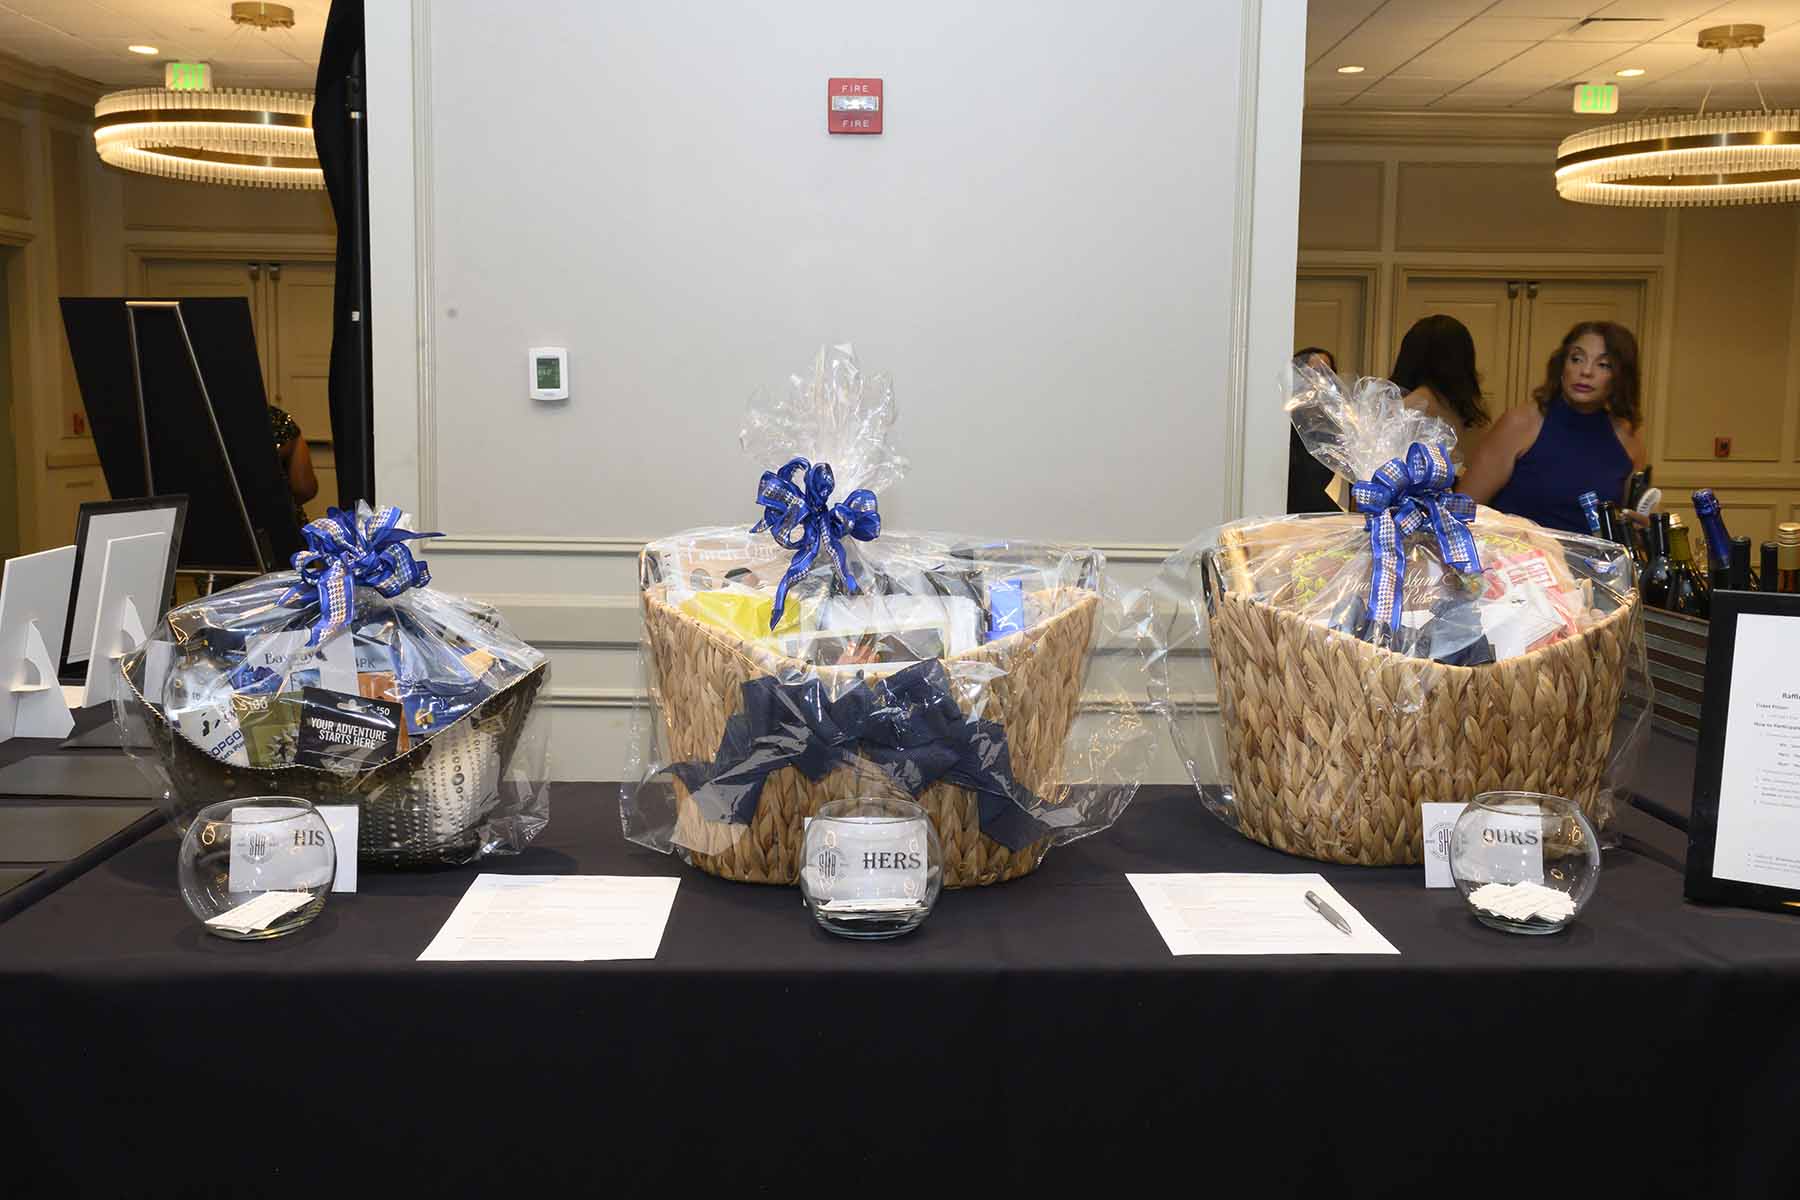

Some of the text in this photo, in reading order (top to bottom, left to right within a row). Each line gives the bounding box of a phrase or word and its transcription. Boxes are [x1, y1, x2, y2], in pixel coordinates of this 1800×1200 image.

[841, 84, 870, 93] FIRE
[1582, 85, 1613, 112] EXIT
[842, 119, 870, 128] FIRE
[1782, 692, 1800, 701] Raffl
[311, 717, 388, 742] YOUR ADVENTURE
[318, 730, 377, 750] STARTS HERE
[294, 829, 326, 847] HIS
[1482, 828, 1539, 846] OURS
[863, 851, 921, 870] HERS
